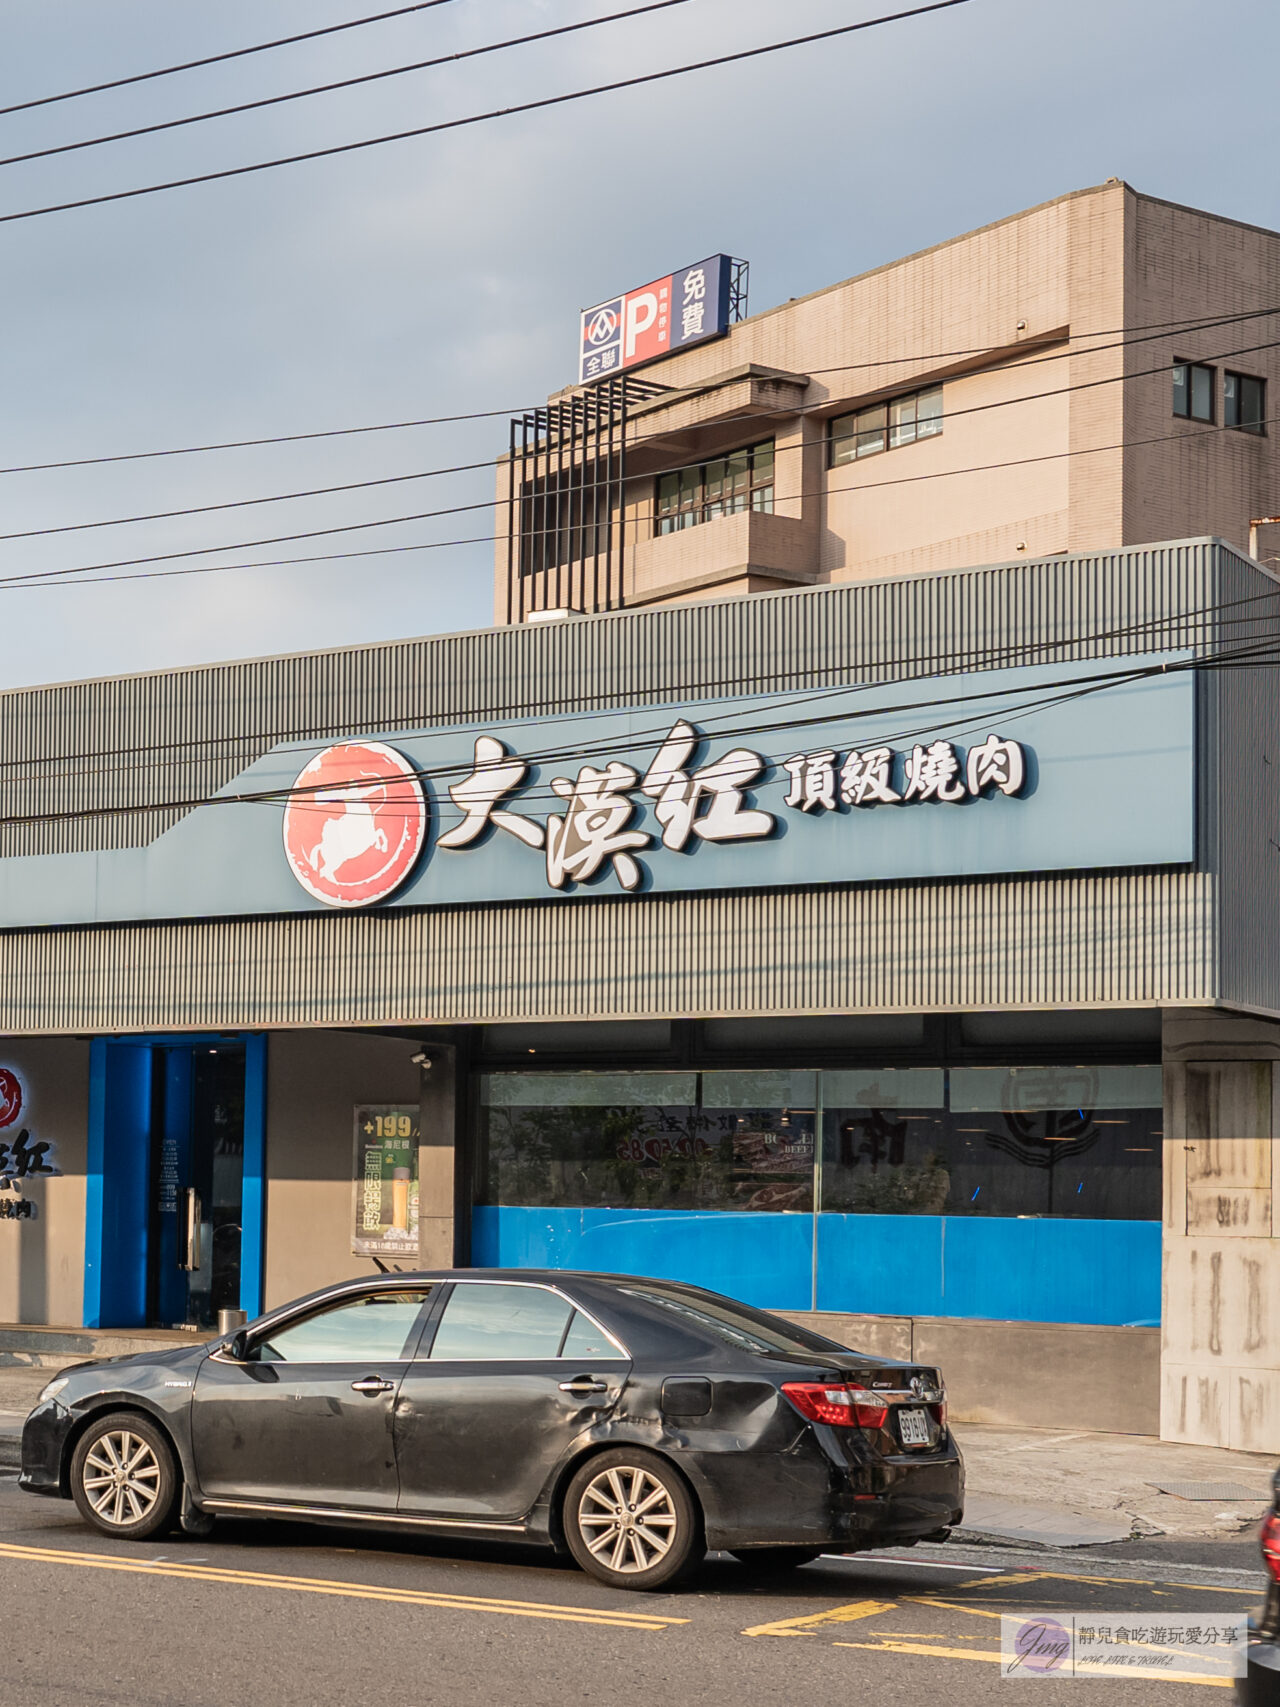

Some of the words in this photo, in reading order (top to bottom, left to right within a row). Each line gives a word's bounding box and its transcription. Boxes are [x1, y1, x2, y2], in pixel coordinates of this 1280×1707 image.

[625, 292, 658, 358] P
[681, 268, 706, 341] 免費
[586, 348, 616, 377] 全聯
[783, 734, 1024, 812] 頂級燒肉
